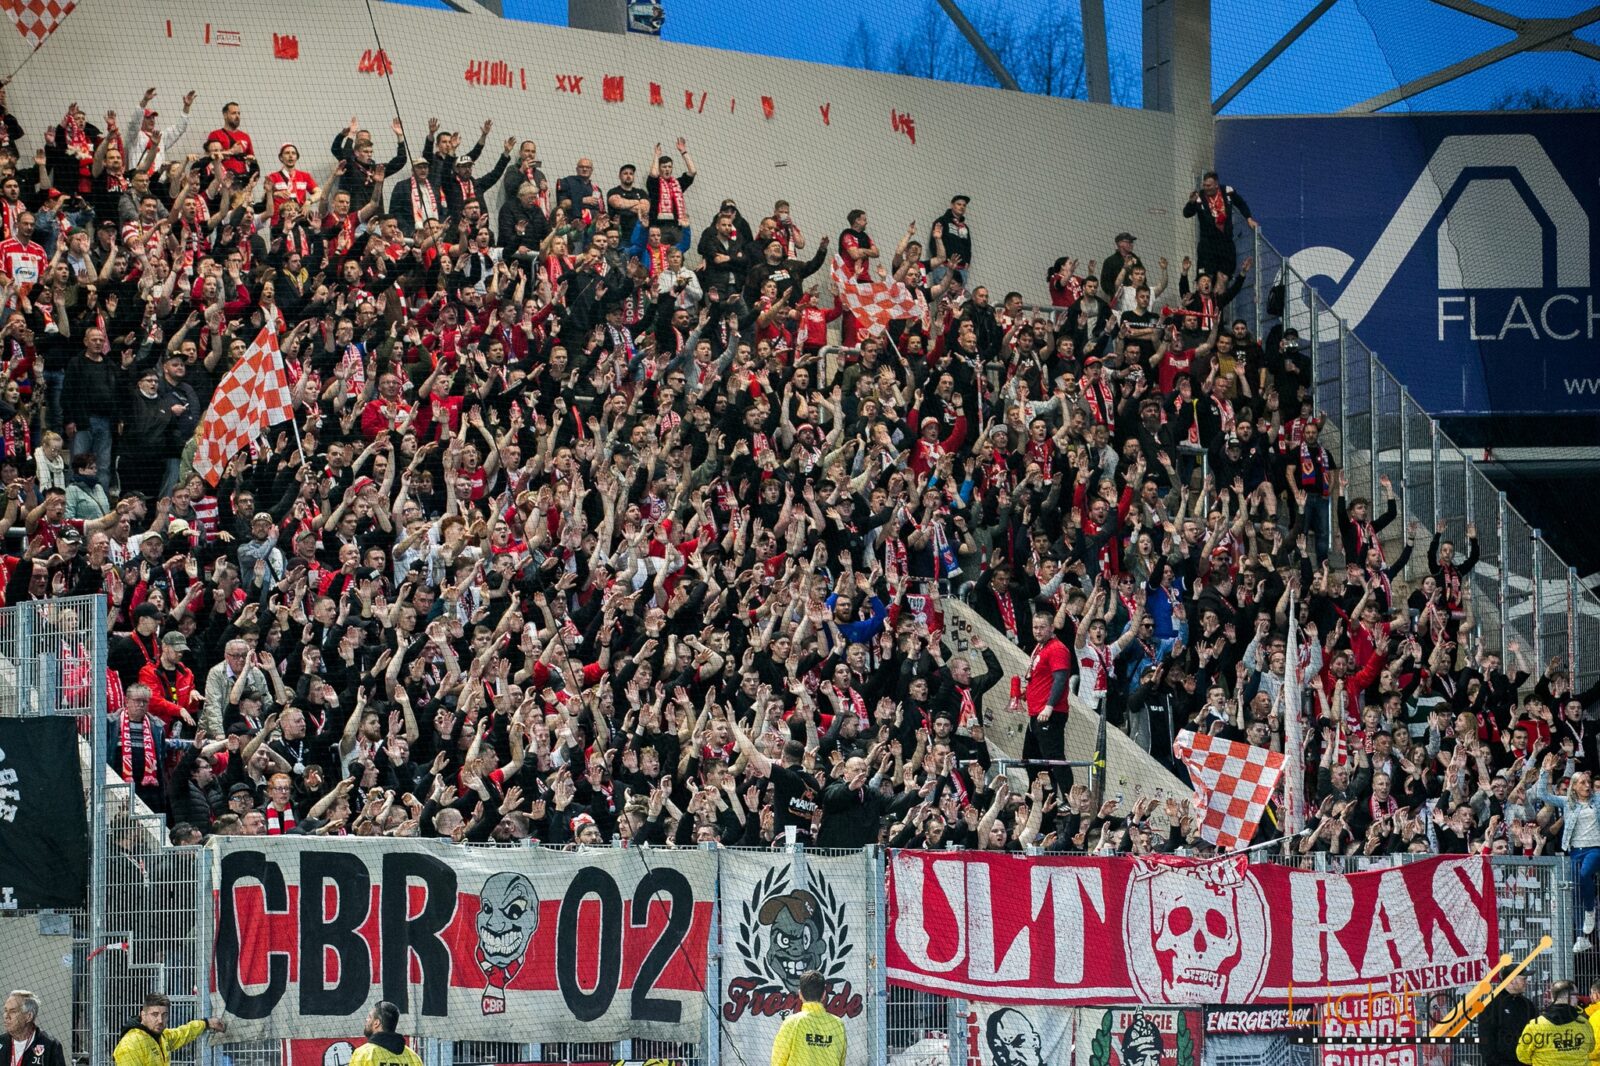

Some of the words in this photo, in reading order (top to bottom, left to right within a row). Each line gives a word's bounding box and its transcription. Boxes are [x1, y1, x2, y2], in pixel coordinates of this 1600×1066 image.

[217, 850, 458, 1019] CBR
[556, 866, 693, 1022] 02
[483, 998, 504, 1013] CBR
